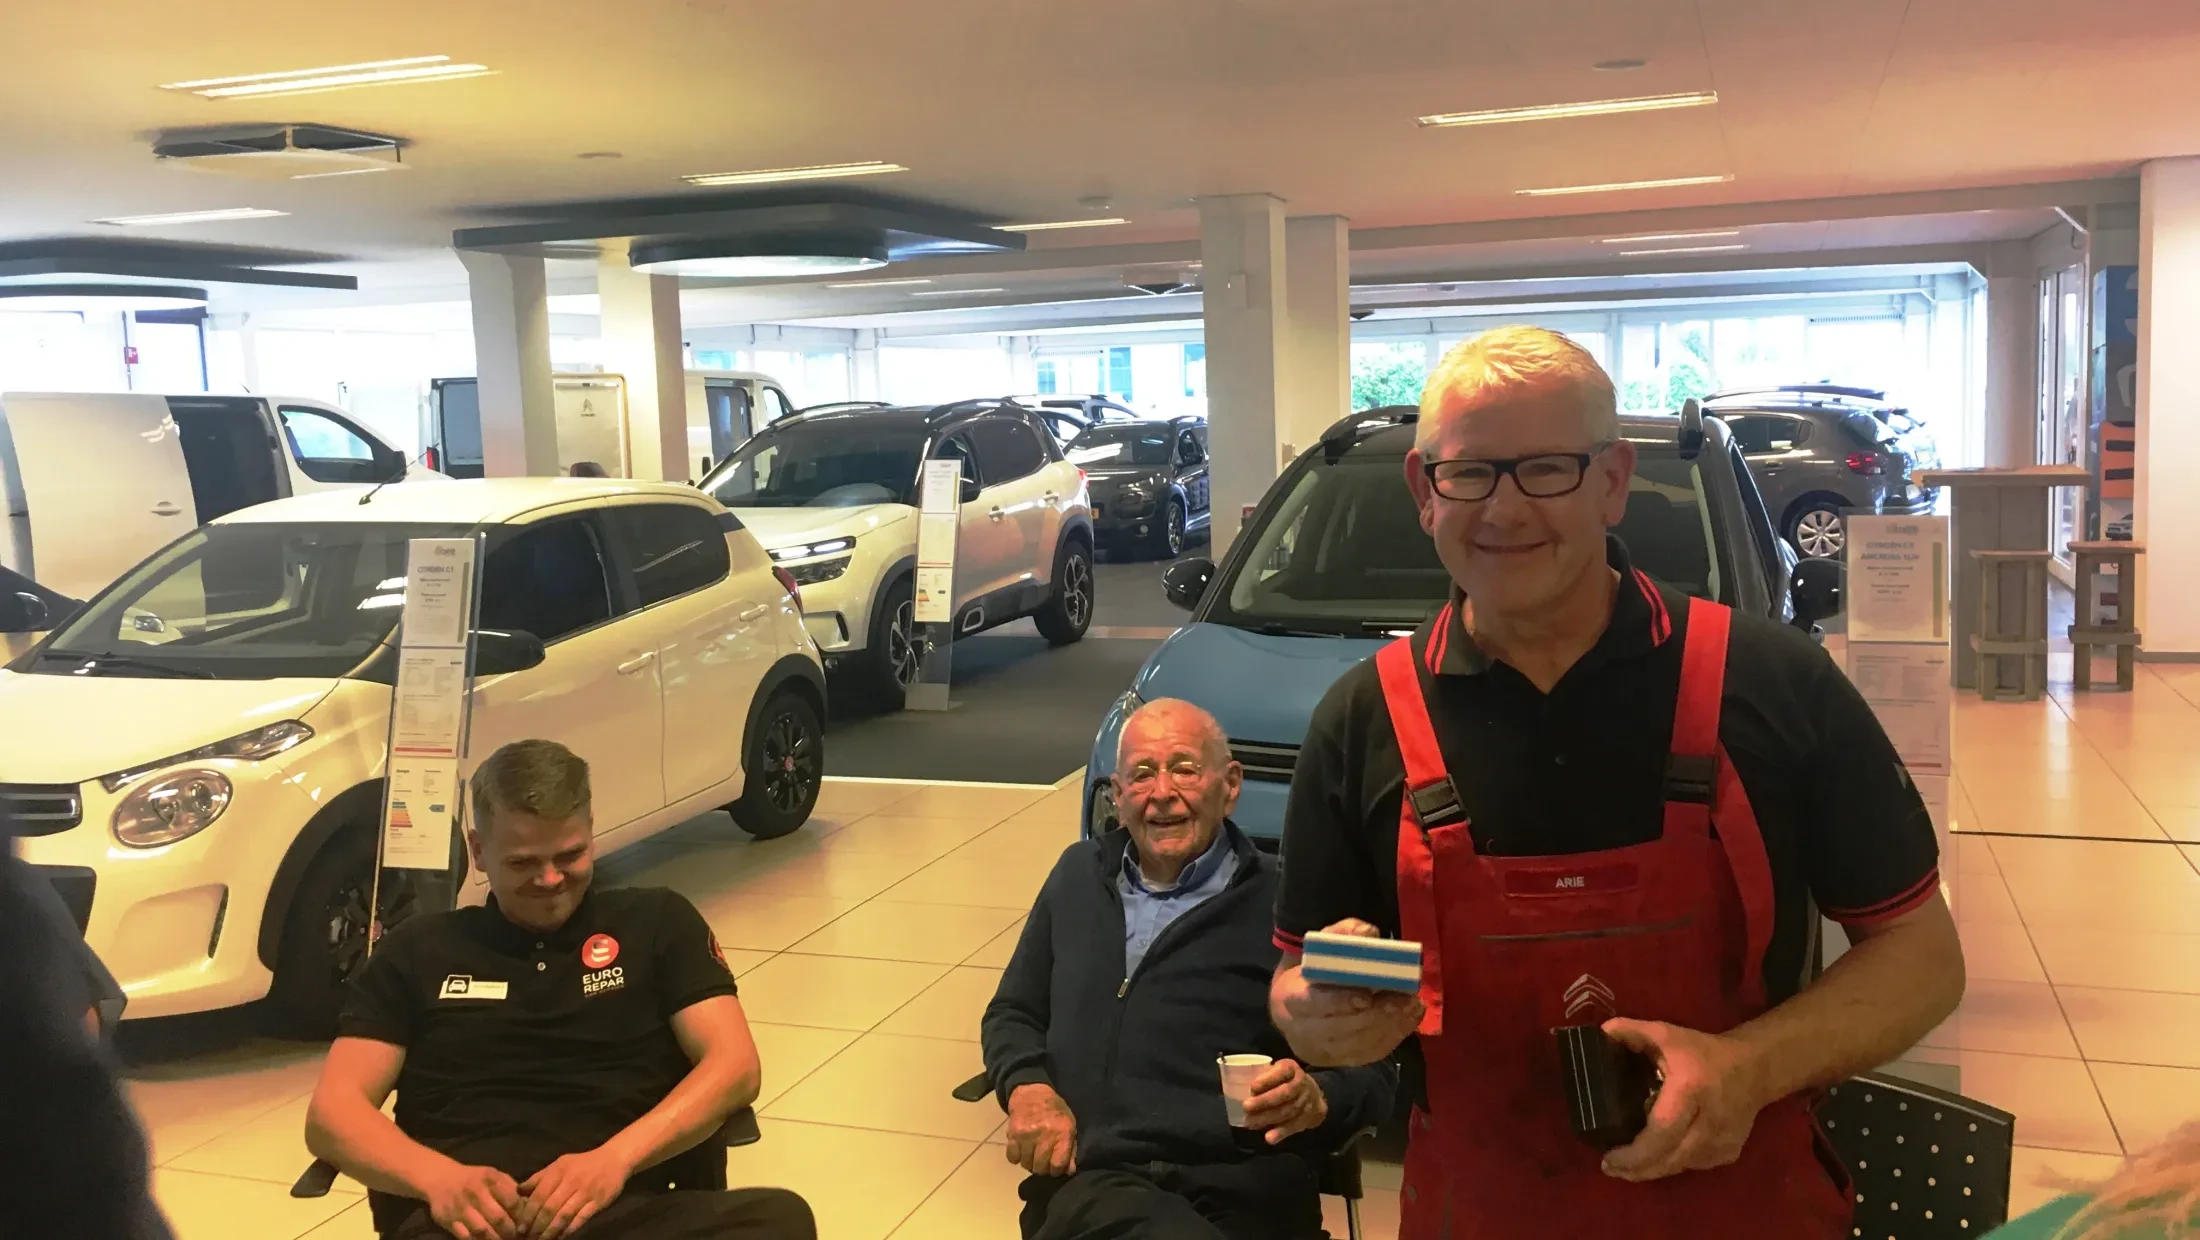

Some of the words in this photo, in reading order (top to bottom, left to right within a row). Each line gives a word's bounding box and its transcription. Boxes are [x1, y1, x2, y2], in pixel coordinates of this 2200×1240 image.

[1555, 876, 1585, 888] ARIE
[582, 966, 623, 985] EURO
[583, 976, 625, 994] REPAR
